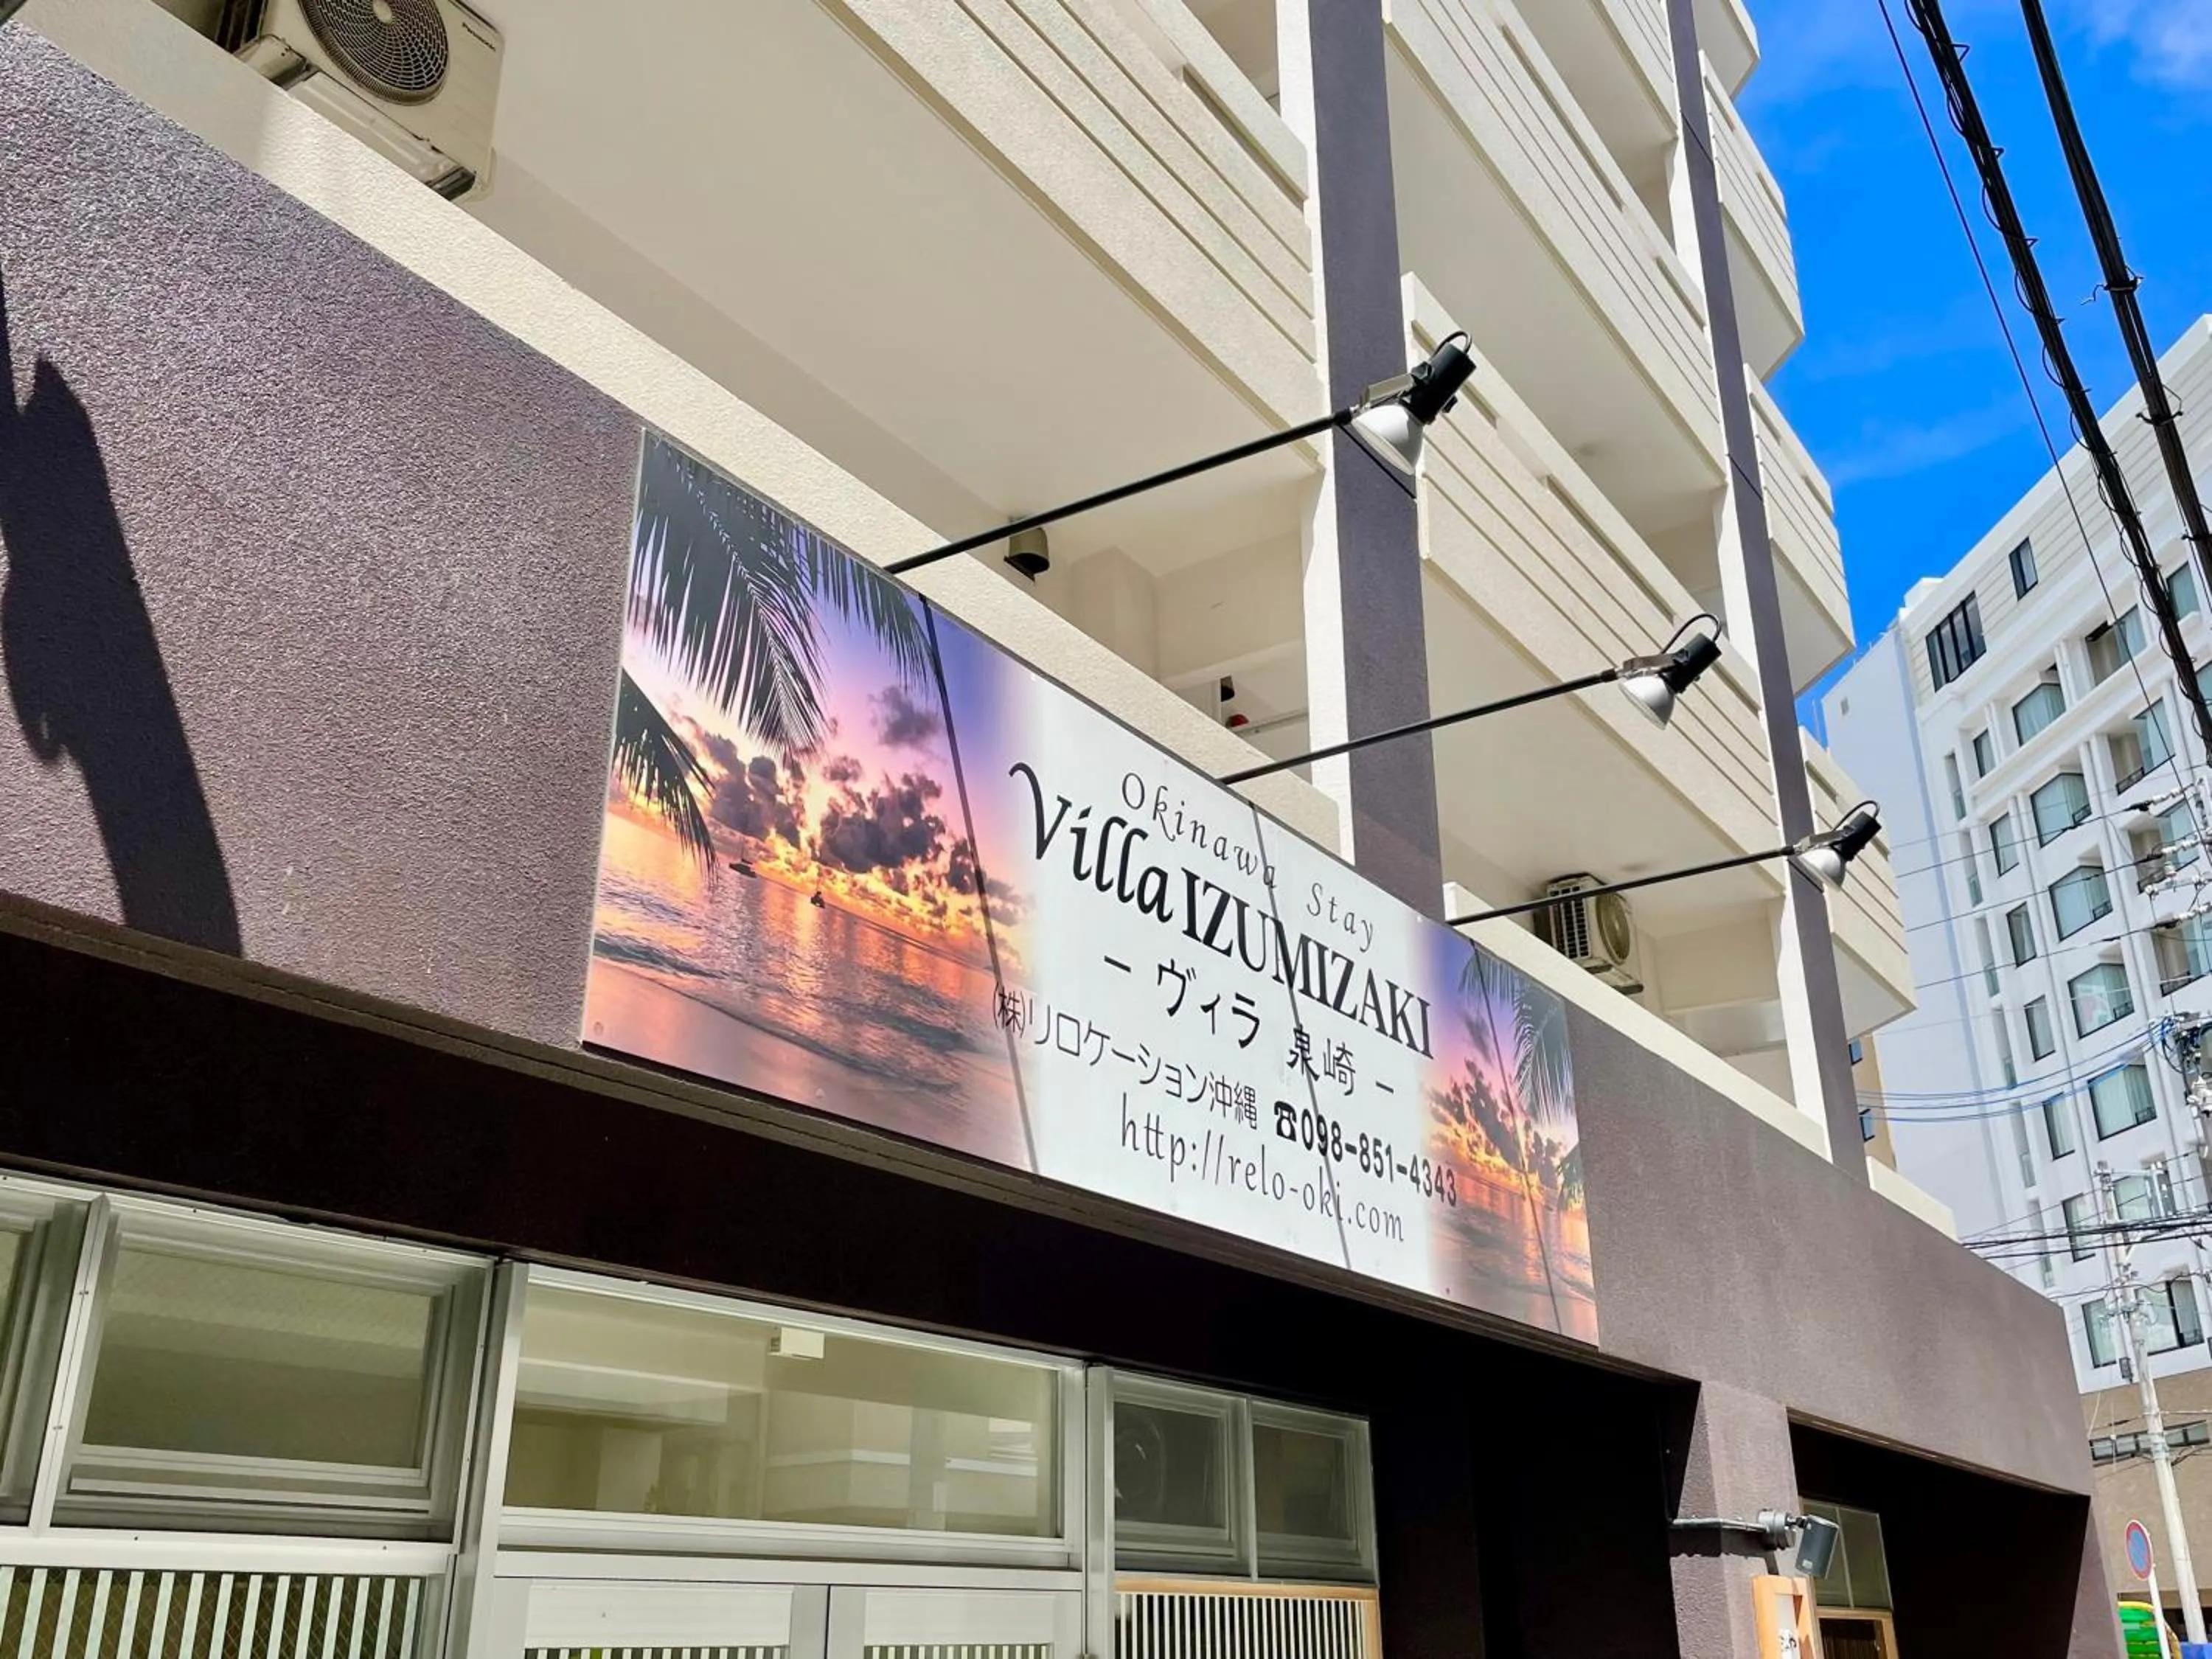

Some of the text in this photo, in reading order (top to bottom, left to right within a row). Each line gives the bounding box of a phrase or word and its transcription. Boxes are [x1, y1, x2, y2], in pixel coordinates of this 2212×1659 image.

[1008, 762, 1434, 1060] Villa IZUMIZAKI
[1121, 772, 1374, 953] Okinawa Stay
[1286, 1023, 1356, 1096] 泉崎
[1121, 1091, 1405, 1242] http://relo-oki.com
